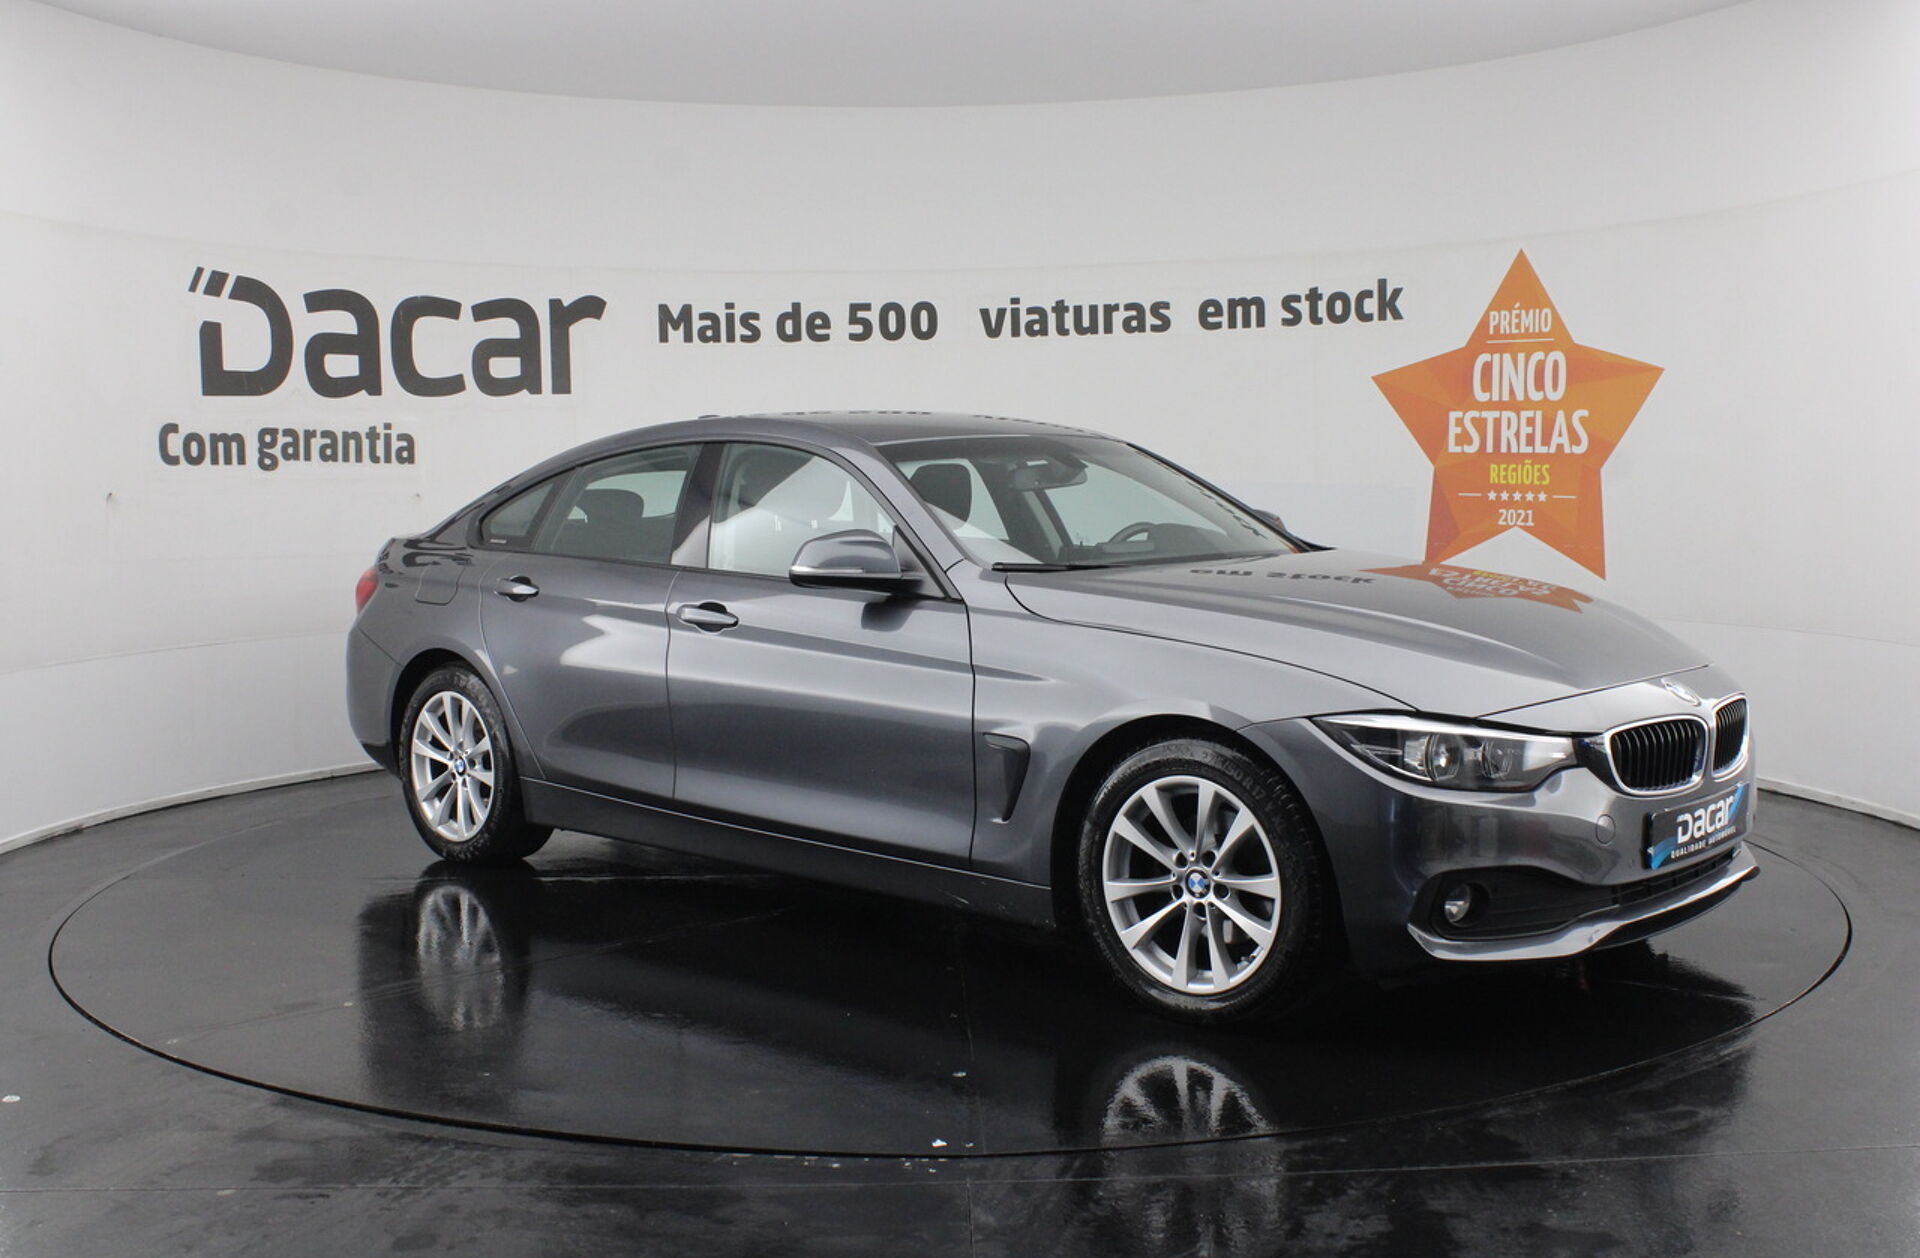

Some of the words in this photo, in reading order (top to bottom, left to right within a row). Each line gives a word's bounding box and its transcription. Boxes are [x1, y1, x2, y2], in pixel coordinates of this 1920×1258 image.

[189, 267, 607, 398] Dacar
[658, 302, 761, 343] Mais
[776, 302, 831, 342] de
[849, 301, 938, 341] 500
[979, 297, 1171, 338] viaturas
[1198, 297, 1266, 330] em
[1281, 279, 1404, 327] stock
[1489, 303, 1552, 335] PRÉMIO
[1473, 351, 1566, 402] CINCO
[159, 423, 246, 466] Com
[258, 423, 415, 471] garantia
[1448, 409, 1589, 454] ESTRELAS
[1489, 459, 1550, 485] REGIÕES
[1498, 509, 1535, 527] 2021
[1677, 795, 1735, 844] Dacar
